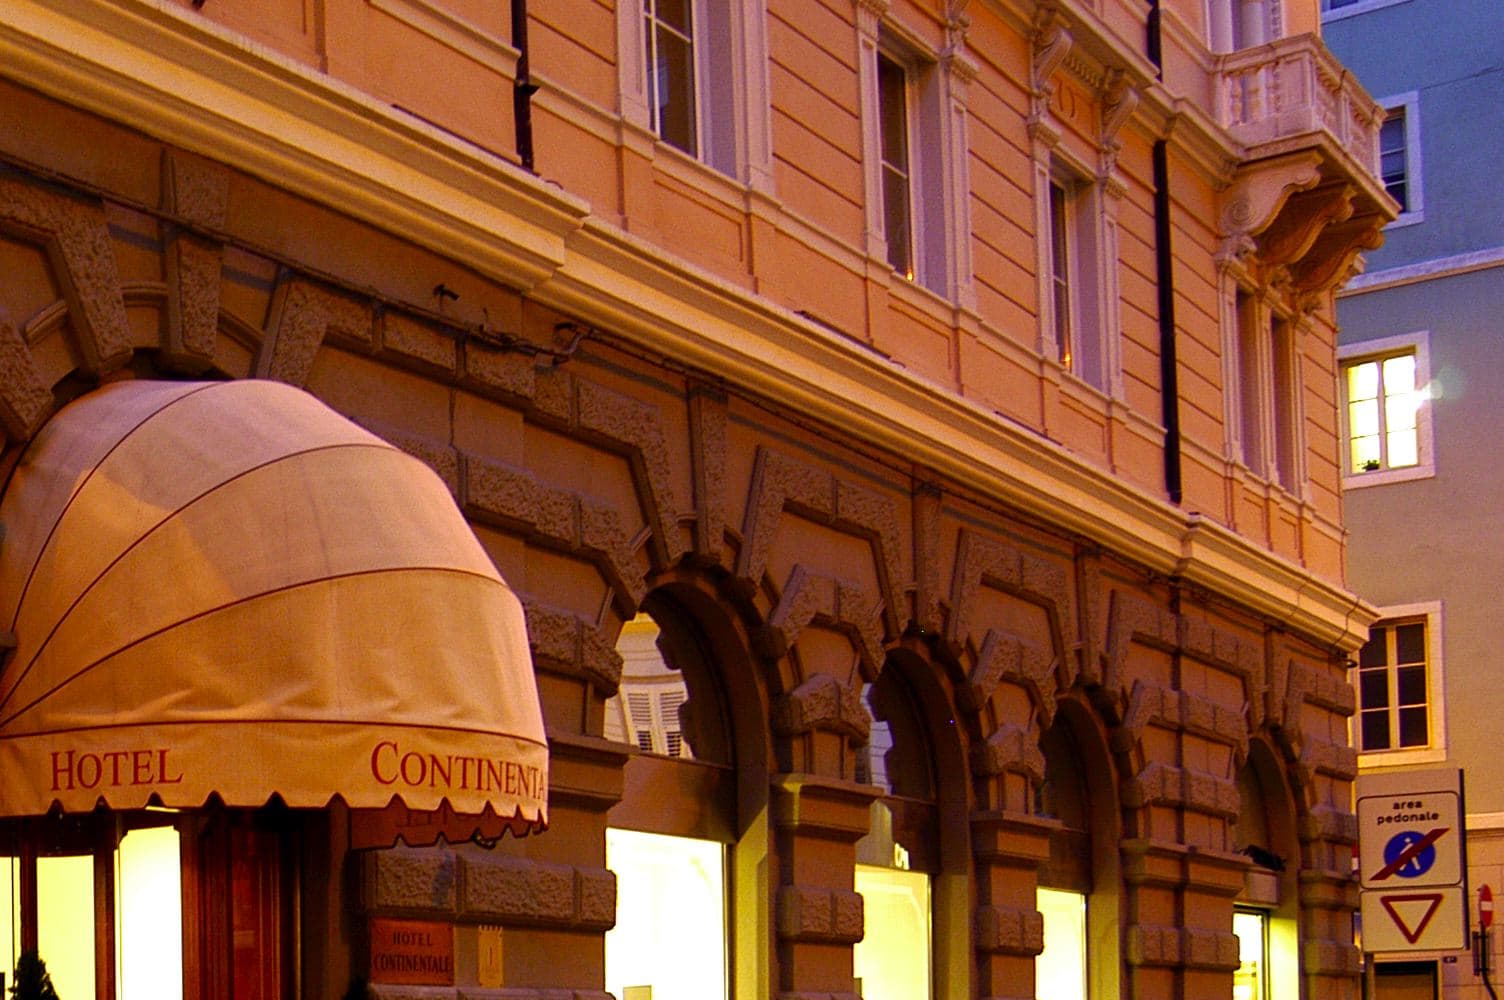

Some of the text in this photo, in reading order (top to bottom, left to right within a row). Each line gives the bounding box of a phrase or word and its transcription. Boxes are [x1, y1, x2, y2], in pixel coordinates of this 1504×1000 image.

[50, 748, 184, 792] HOTEL
[1393, 800, 1422, 810] area
[1377, 811, 1439, 826] pedonale
[392, 932, 433, 947] HOTEL
[374, 952, 450, 974] CONTINENTALE
